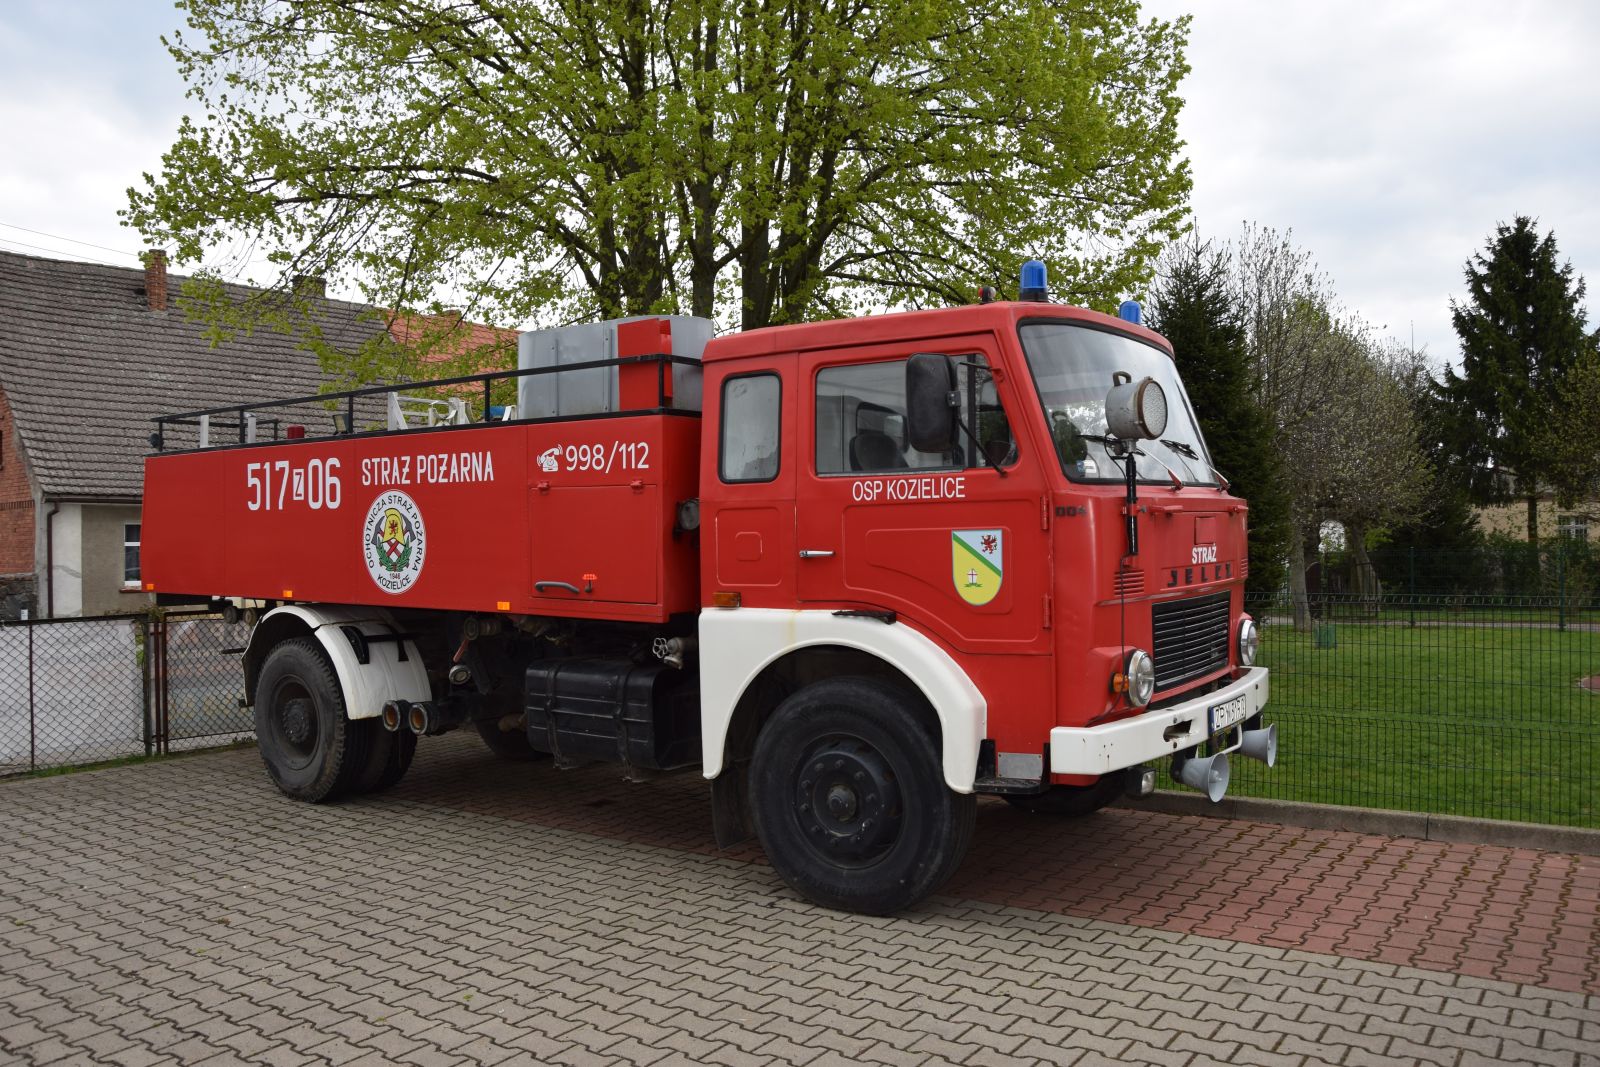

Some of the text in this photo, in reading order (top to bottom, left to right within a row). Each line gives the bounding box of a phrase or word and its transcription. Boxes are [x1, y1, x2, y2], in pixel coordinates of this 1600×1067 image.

[566, 441, 649, 473] 998/112
[852, 477, 966, 501] OSP KOZIELICE
[365, 495, 423, 571] OCHOTNICZA STRAŻ POŻARNA
[1192, 543, 1217, 564] STRAŻ
[377, 575, 411, 590] KOZIELICE
